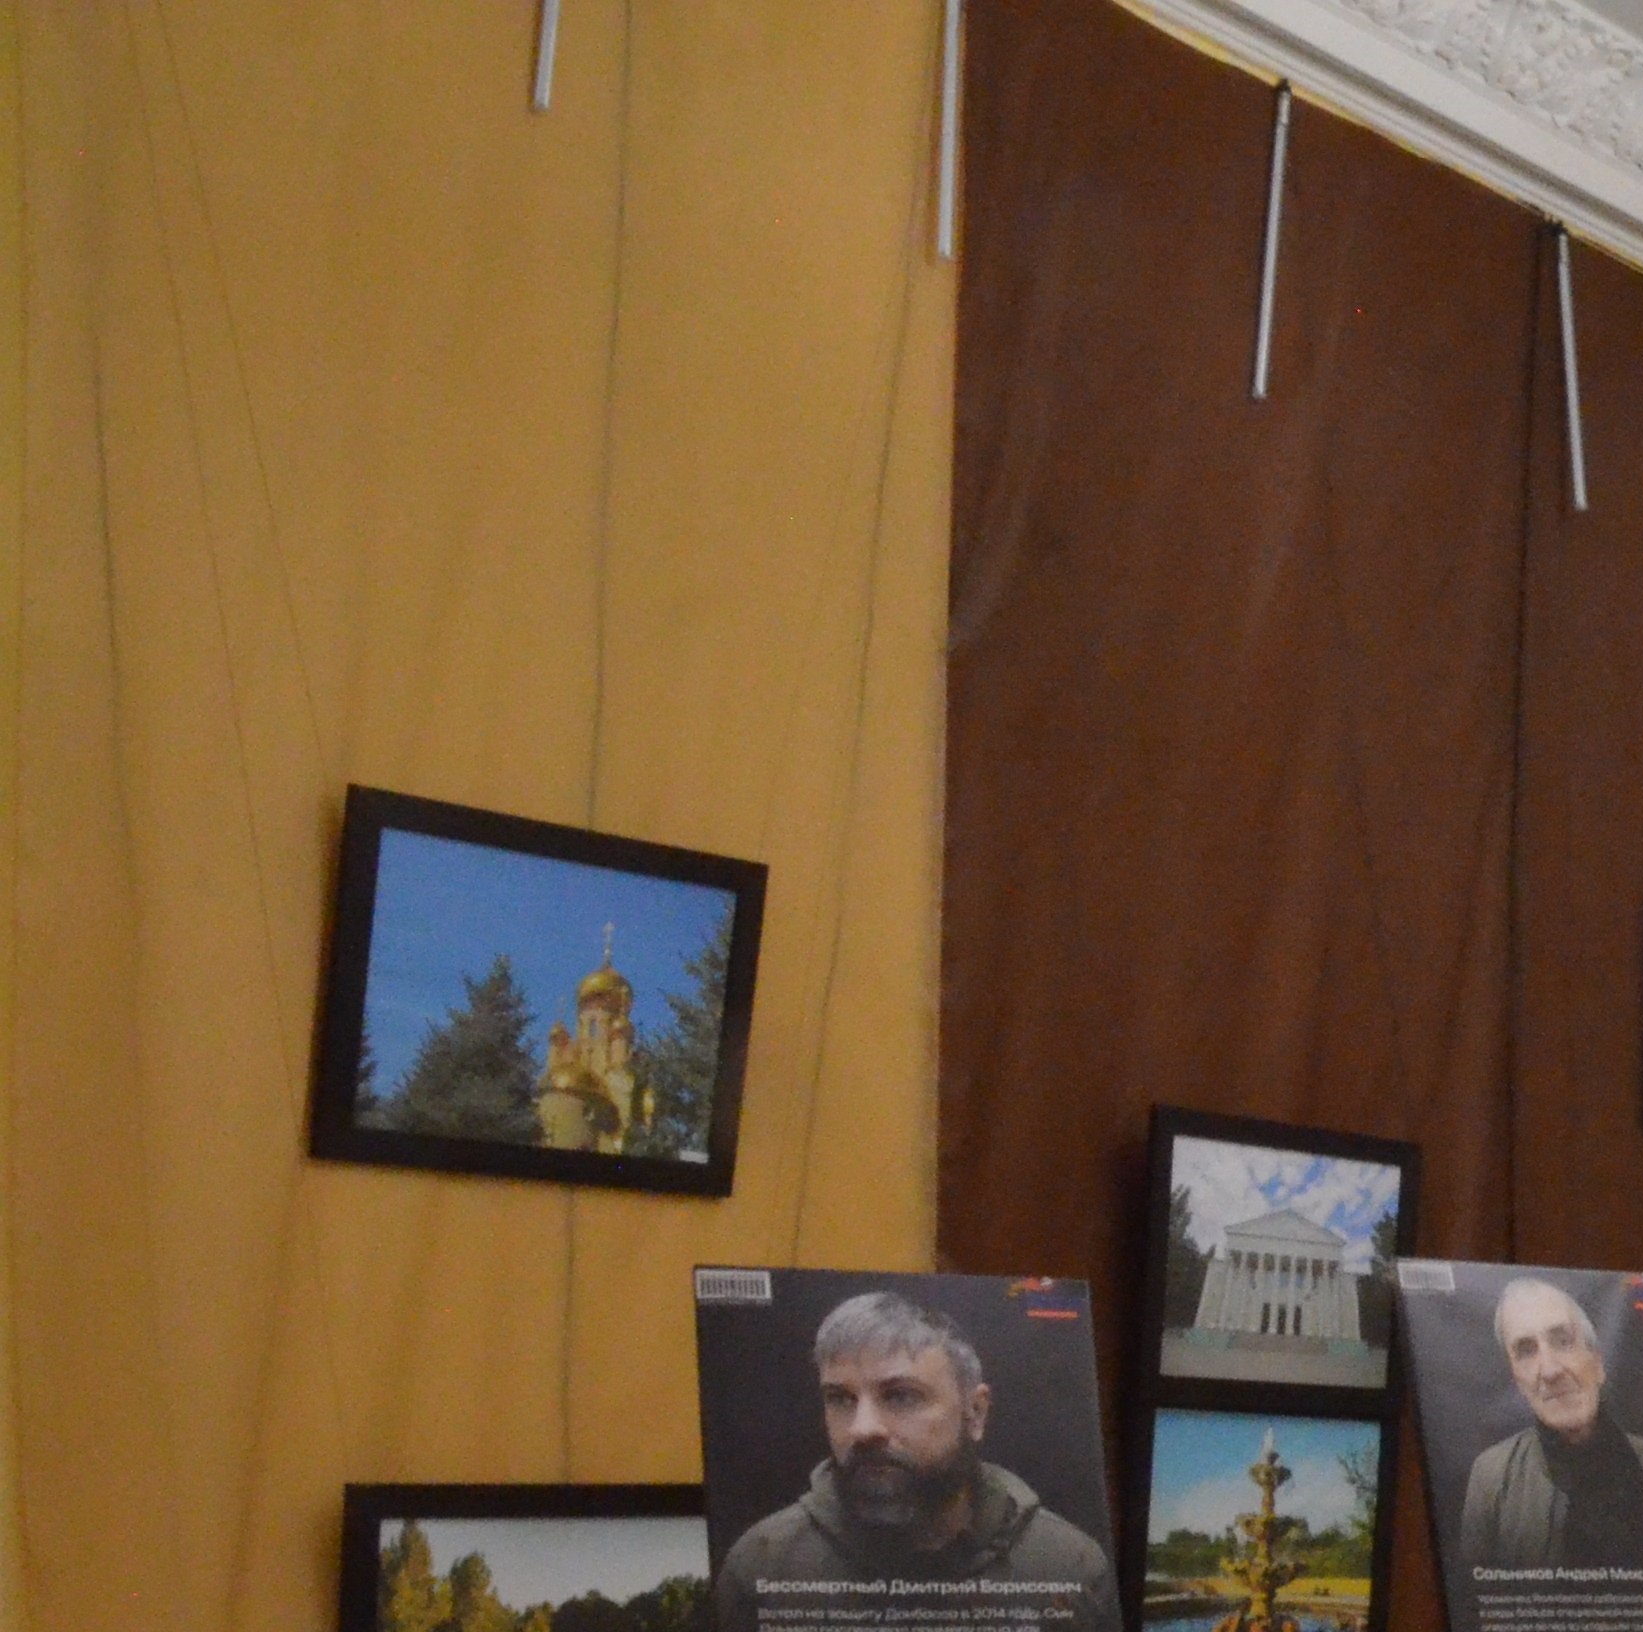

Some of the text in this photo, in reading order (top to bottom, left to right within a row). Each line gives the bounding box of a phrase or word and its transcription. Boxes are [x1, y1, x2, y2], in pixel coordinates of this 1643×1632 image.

[1472, 1568, 1554, 1579] Сальников
[1554, 1567, 1608, 1580] Андрей
[755, 1578, 1081, 1596] Бессмертный Дмитрий Борисович
